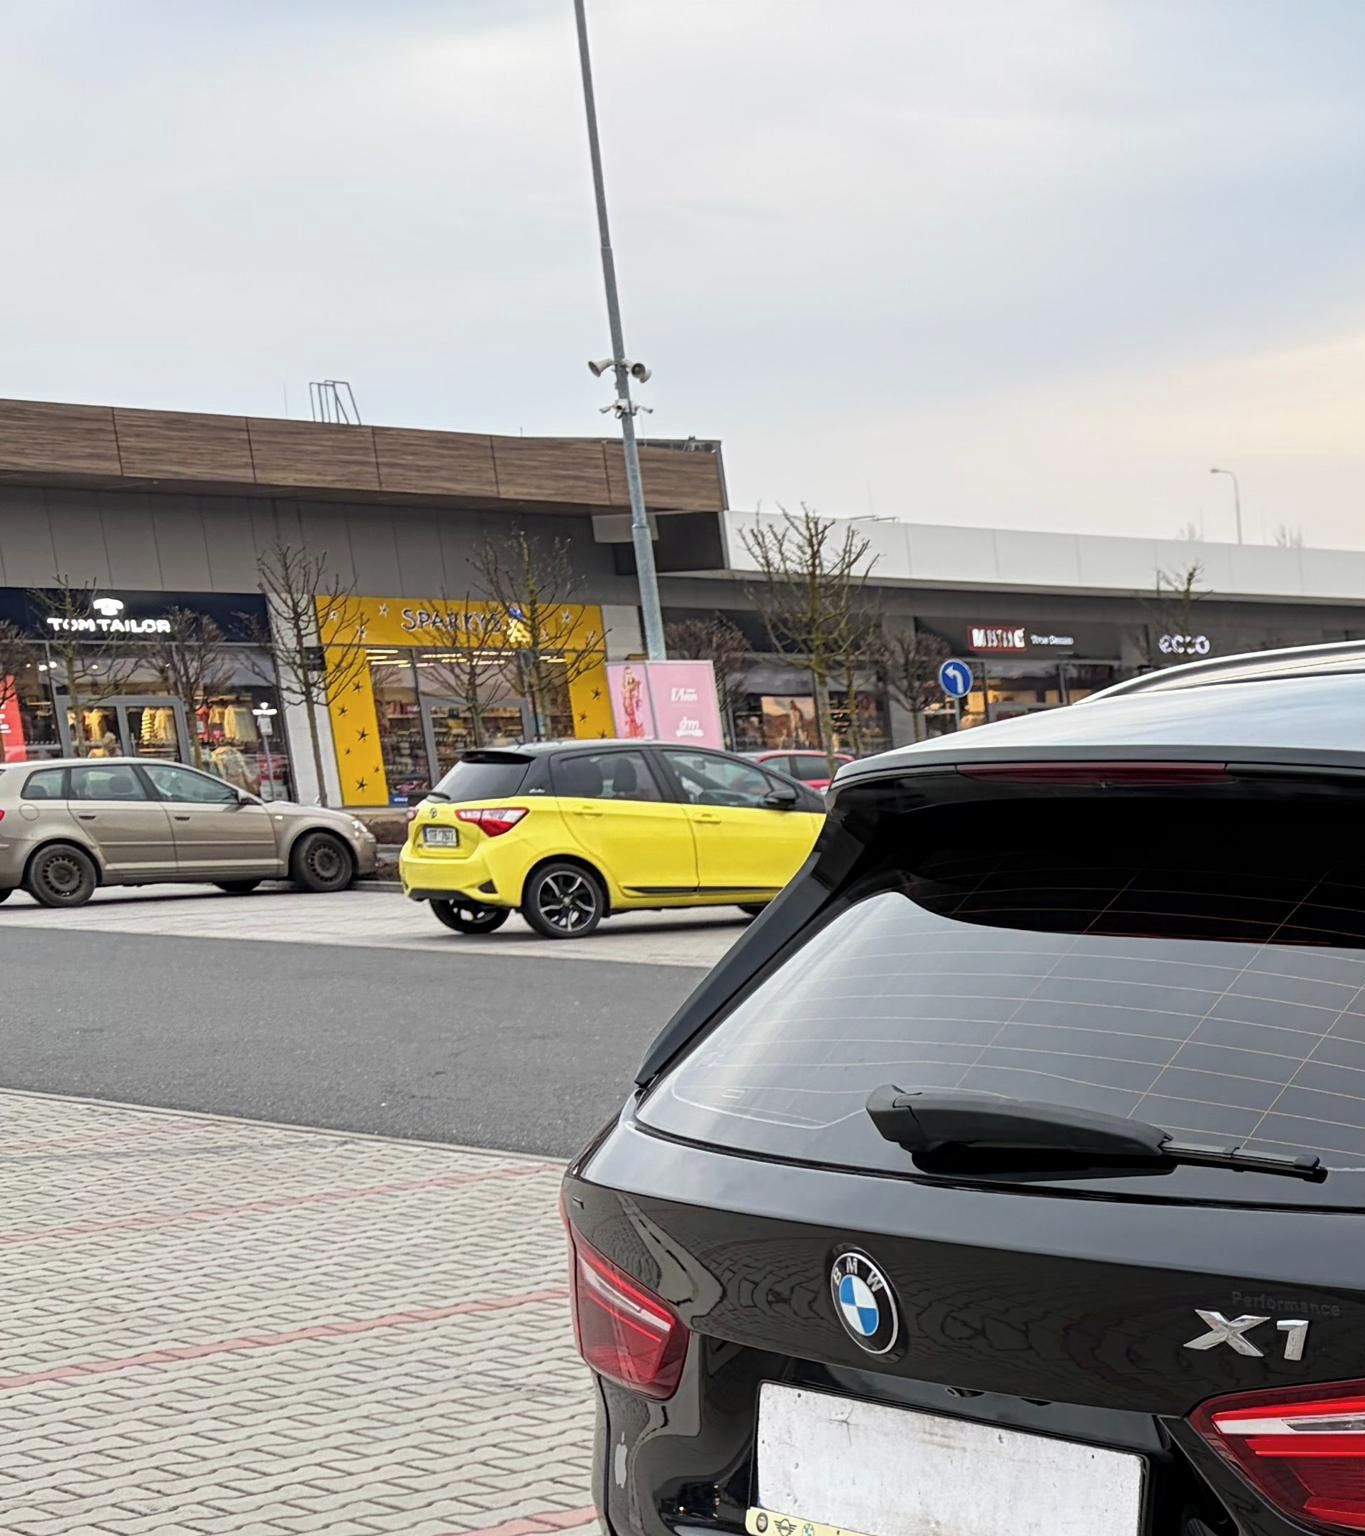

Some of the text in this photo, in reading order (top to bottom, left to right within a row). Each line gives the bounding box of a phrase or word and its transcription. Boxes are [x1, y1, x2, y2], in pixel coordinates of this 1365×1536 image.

[46, 617, 171, 633] TOM TAILOR
[833, 1257, 883, 1293] BMW
[1231, 1291, 1341, 1316] Performance
[1183, 1308, 1309, 1361] X1
